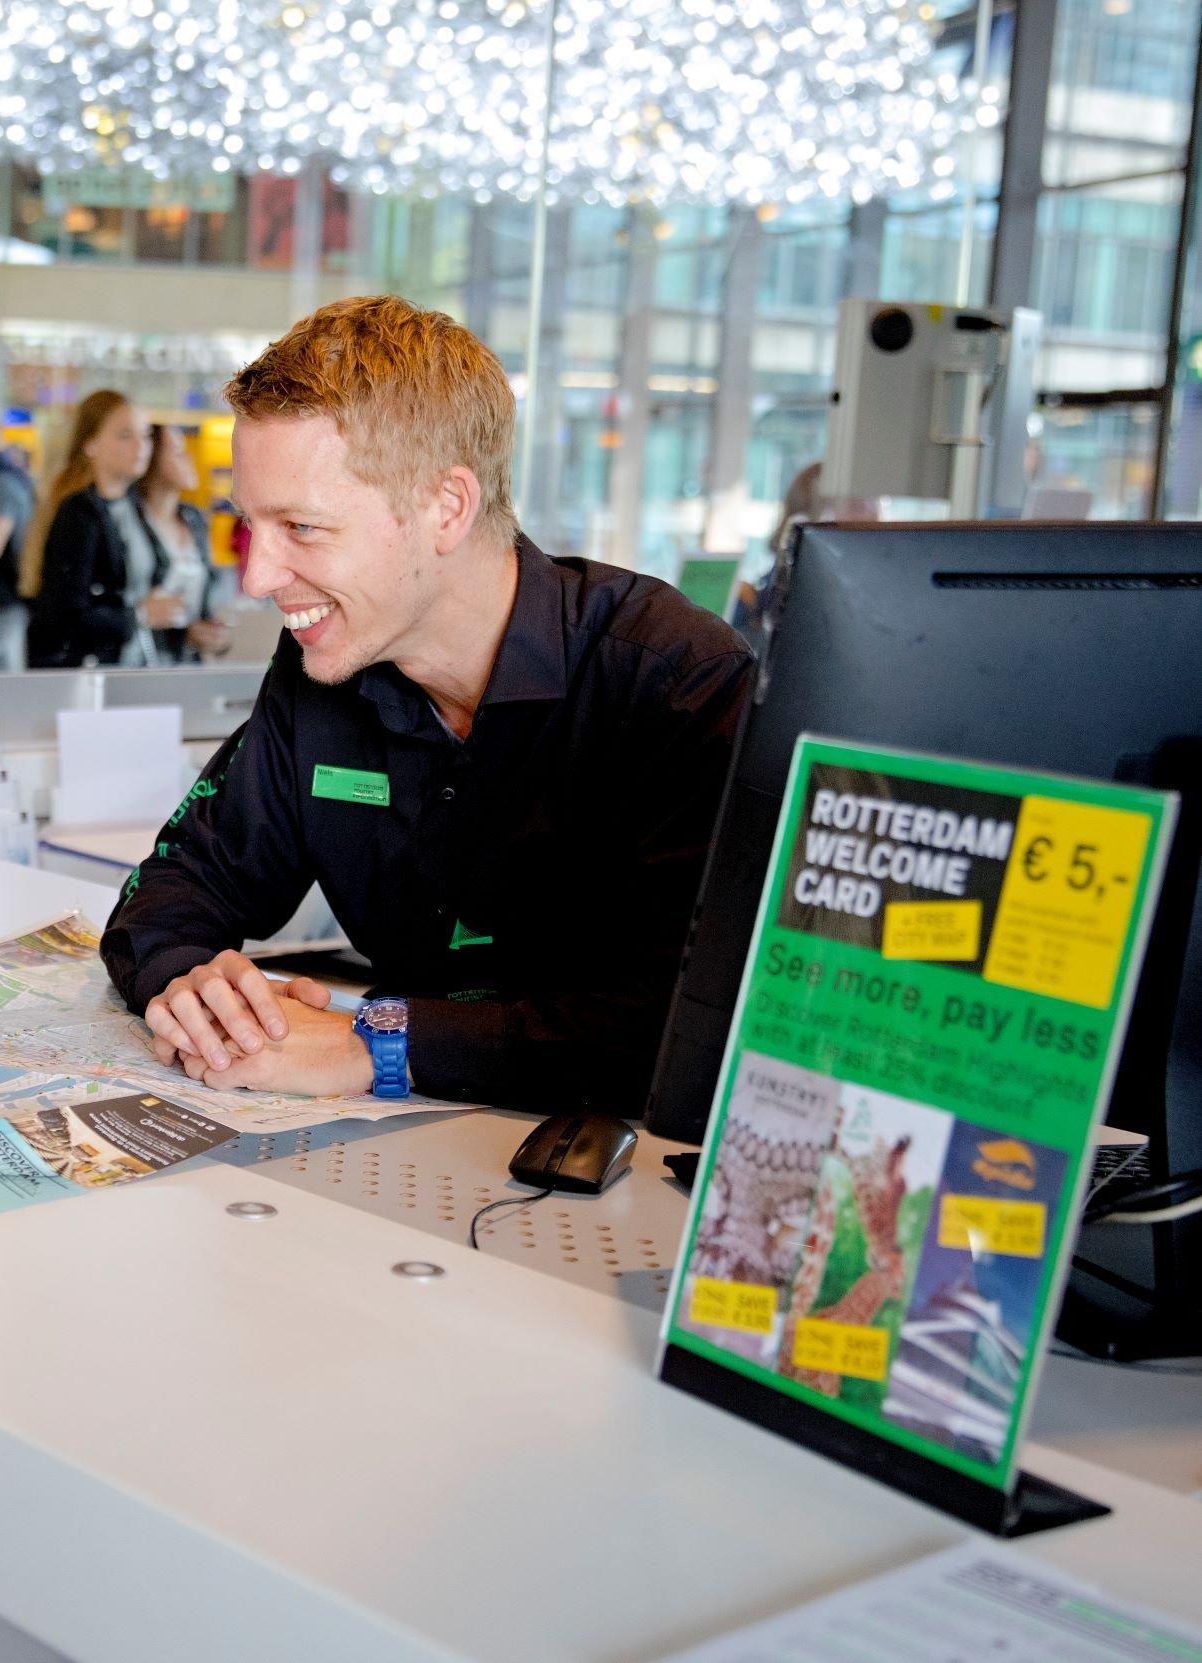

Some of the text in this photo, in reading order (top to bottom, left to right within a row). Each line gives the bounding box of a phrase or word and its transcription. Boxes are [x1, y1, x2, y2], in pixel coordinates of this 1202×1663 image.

[811, 789, 1015, 860] ROTTERDAM
[794, 868, 883, 918] CARD
[805, 829, 972, 896] WELCOME
[1024, 836, 1130, 902] € 5,-
[762, 942, 1104, 1062] See more, pay less
